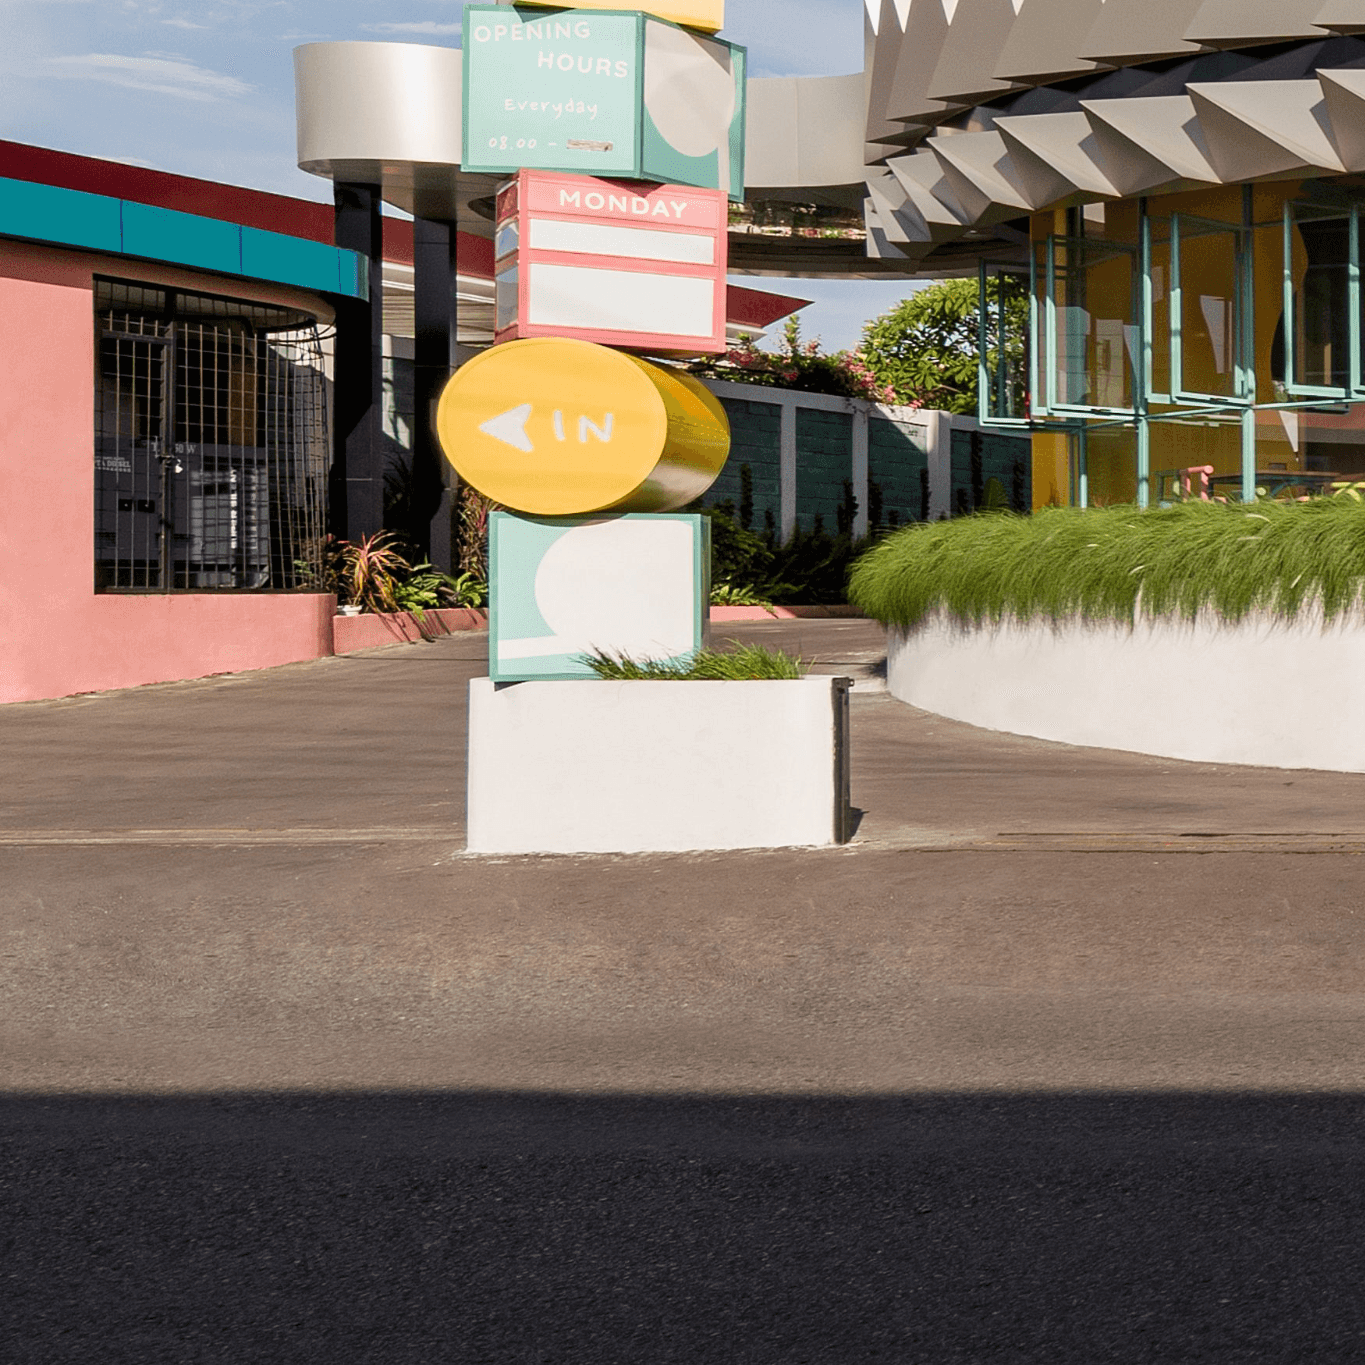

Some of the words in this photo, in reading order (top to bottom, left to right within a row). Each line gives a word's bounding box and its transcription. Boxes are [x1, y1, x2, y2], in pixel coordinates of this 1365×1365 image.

[473, 20, 592, 43] OPENING
[537, 49, 629, 79] HOURS
[503, 97, 599, 121] Everyday
[488, 135, 537, 150] 08.00
[558, 189, 688, 219] MONDAY
[553, 409, 615, 443] IN
